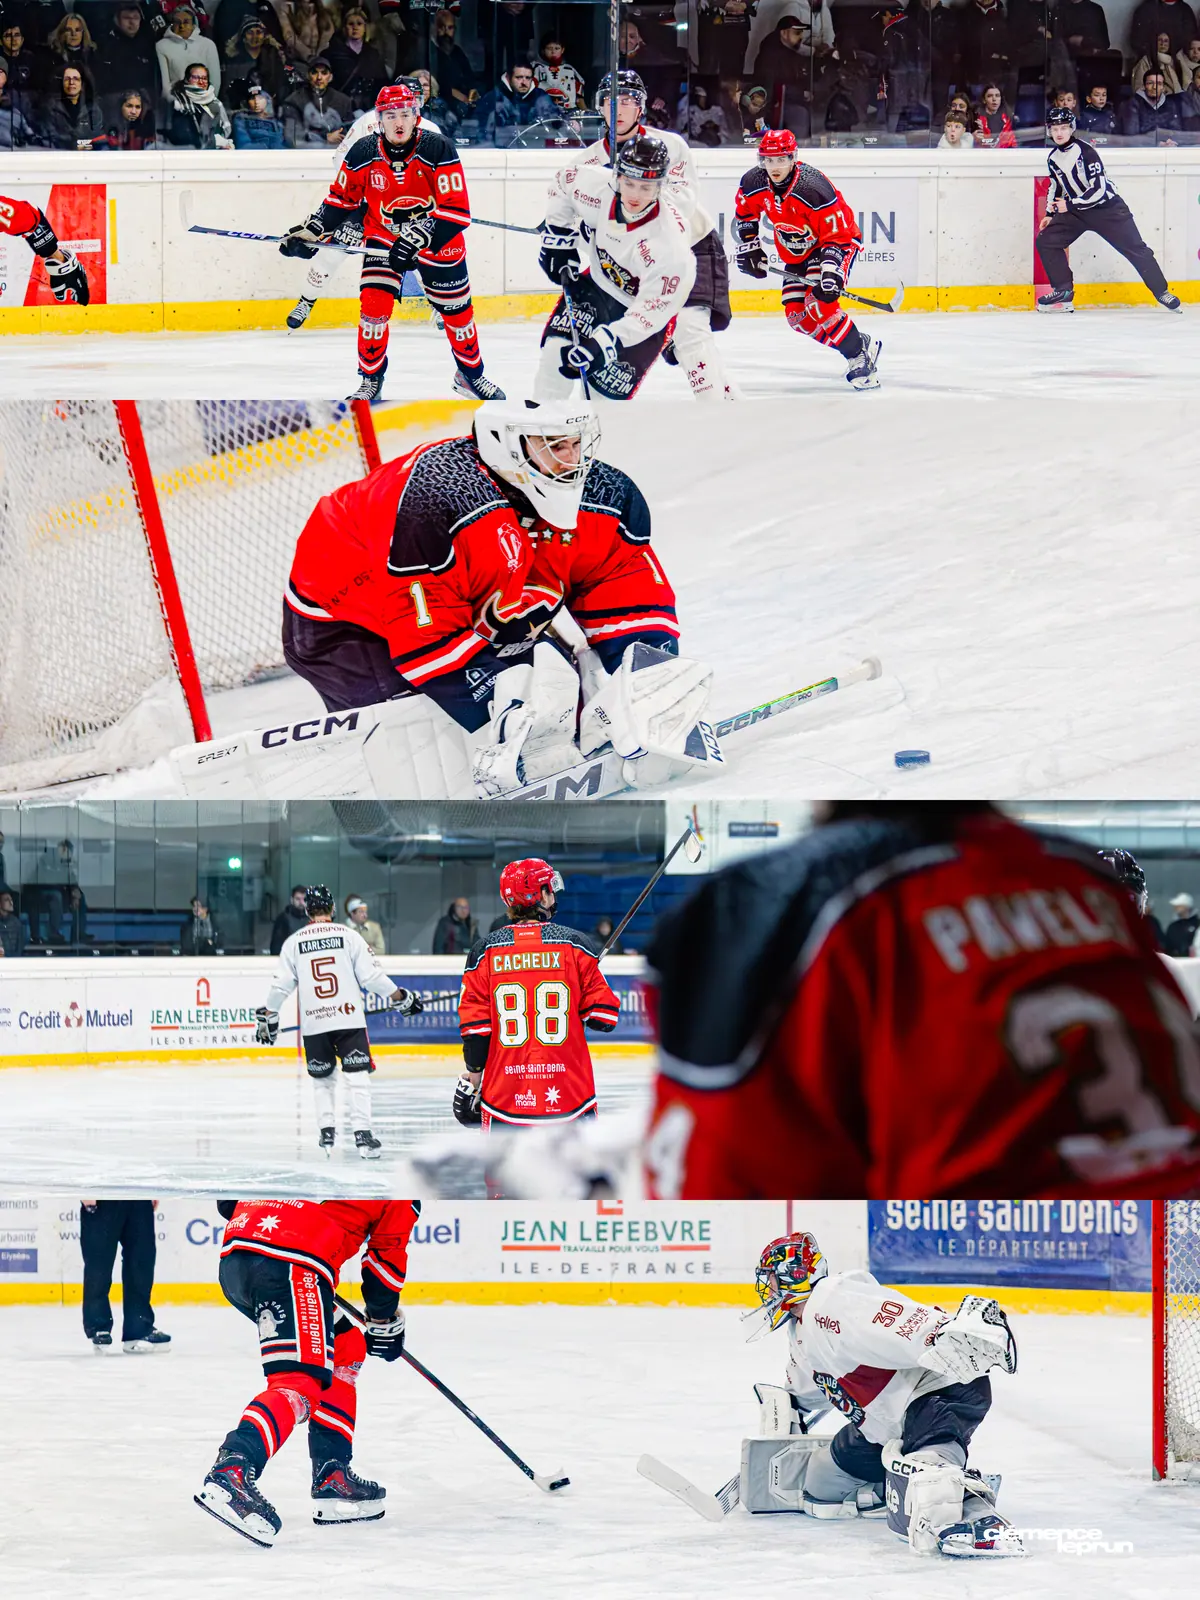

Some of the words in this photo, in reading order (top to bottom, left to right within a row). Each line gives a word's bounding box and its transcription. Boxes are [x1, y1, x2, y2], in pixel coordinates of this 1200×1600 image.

[1088, 162, 1102, 176] 59
[437, 171, 464, 195] 80
[825, 210, 849, 233] 77
[543, 235, 576, 247] CM
[660, 276, 682, 297] 19
[362, 322, 384, 341] 80
[455, 322, 475, 342] 80
[566, 414, 588, 424] CCM
[409, 580, 433, 629] 1
[714, 704, 772, 739] CCM
[796, 690, 813, 703] PRO
[261, 711, 360, 749] CCM
[699, 720, 724, 763] CCM
[301, 938, 341, 953] KARLSSON
[493, 952, 561, 972] CACHEUX
[310, 956, 340, 999] 5
[18, 1008, 61, 1031] Crédit
[86, 1009, 133, 1028] Mutuel
[150, 1010, 182, 1024] JEAN
[187, 1008, 256, 1024] LEFEBVRE
[494, 980, 571, 1048] 88
[501, 1220, 567, 1242] JEAN
[580, 1220, 711, 1242] LEFEBVRE
[563, 1245, 606, 1254] TRAVAILLE
[609, 1245, 633, 1254] POUR
[635, 1245, 660, 1253] VOUS
[938, 1238, 957, 1257] LE
[966, 1237, 1089, 1260] DÉPARTEMENT
[870, 1300, 903, 1328] 30
